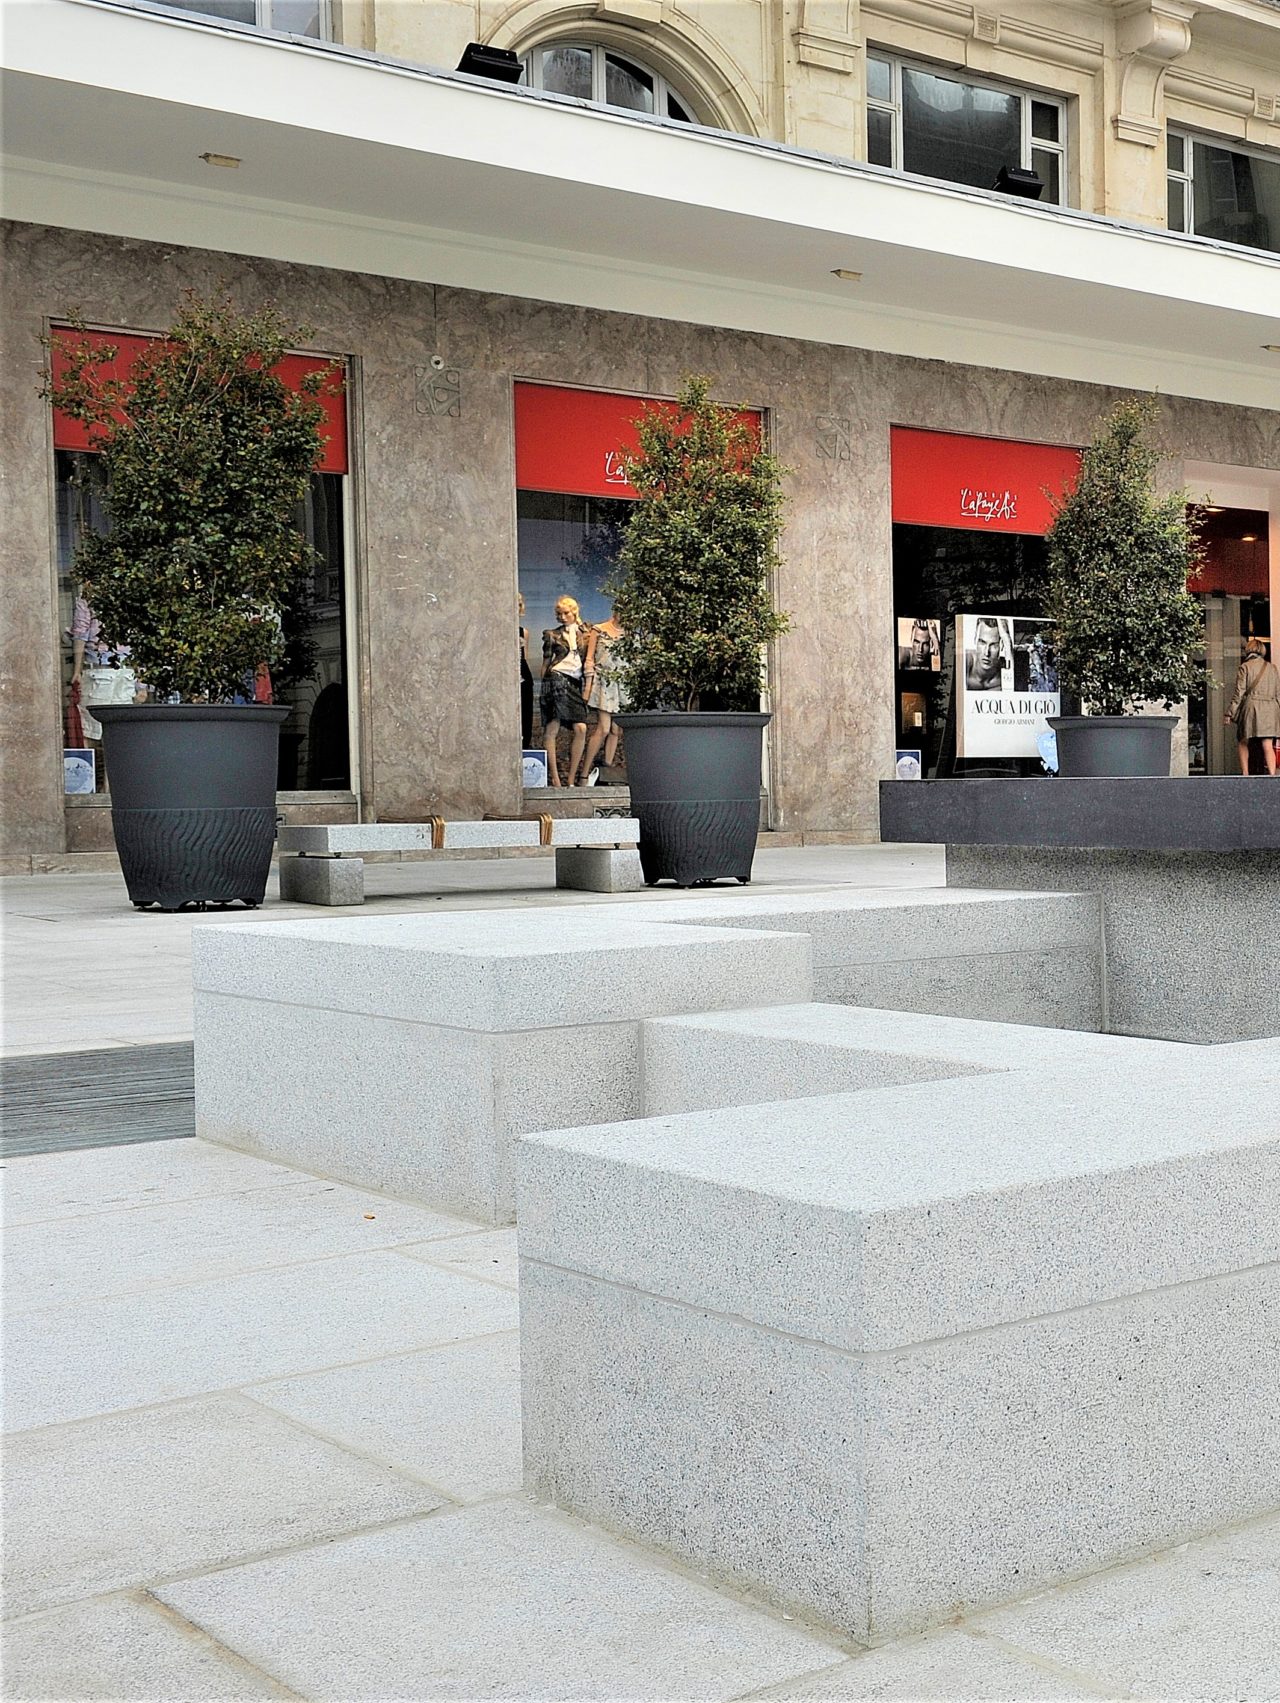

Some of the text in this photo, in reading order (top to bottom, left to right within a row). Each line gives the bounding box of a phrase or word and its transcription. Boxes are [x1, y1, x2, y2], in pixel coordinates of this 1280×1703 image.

[971, 699, 1056, 715] ACQUA DI GIÒ
